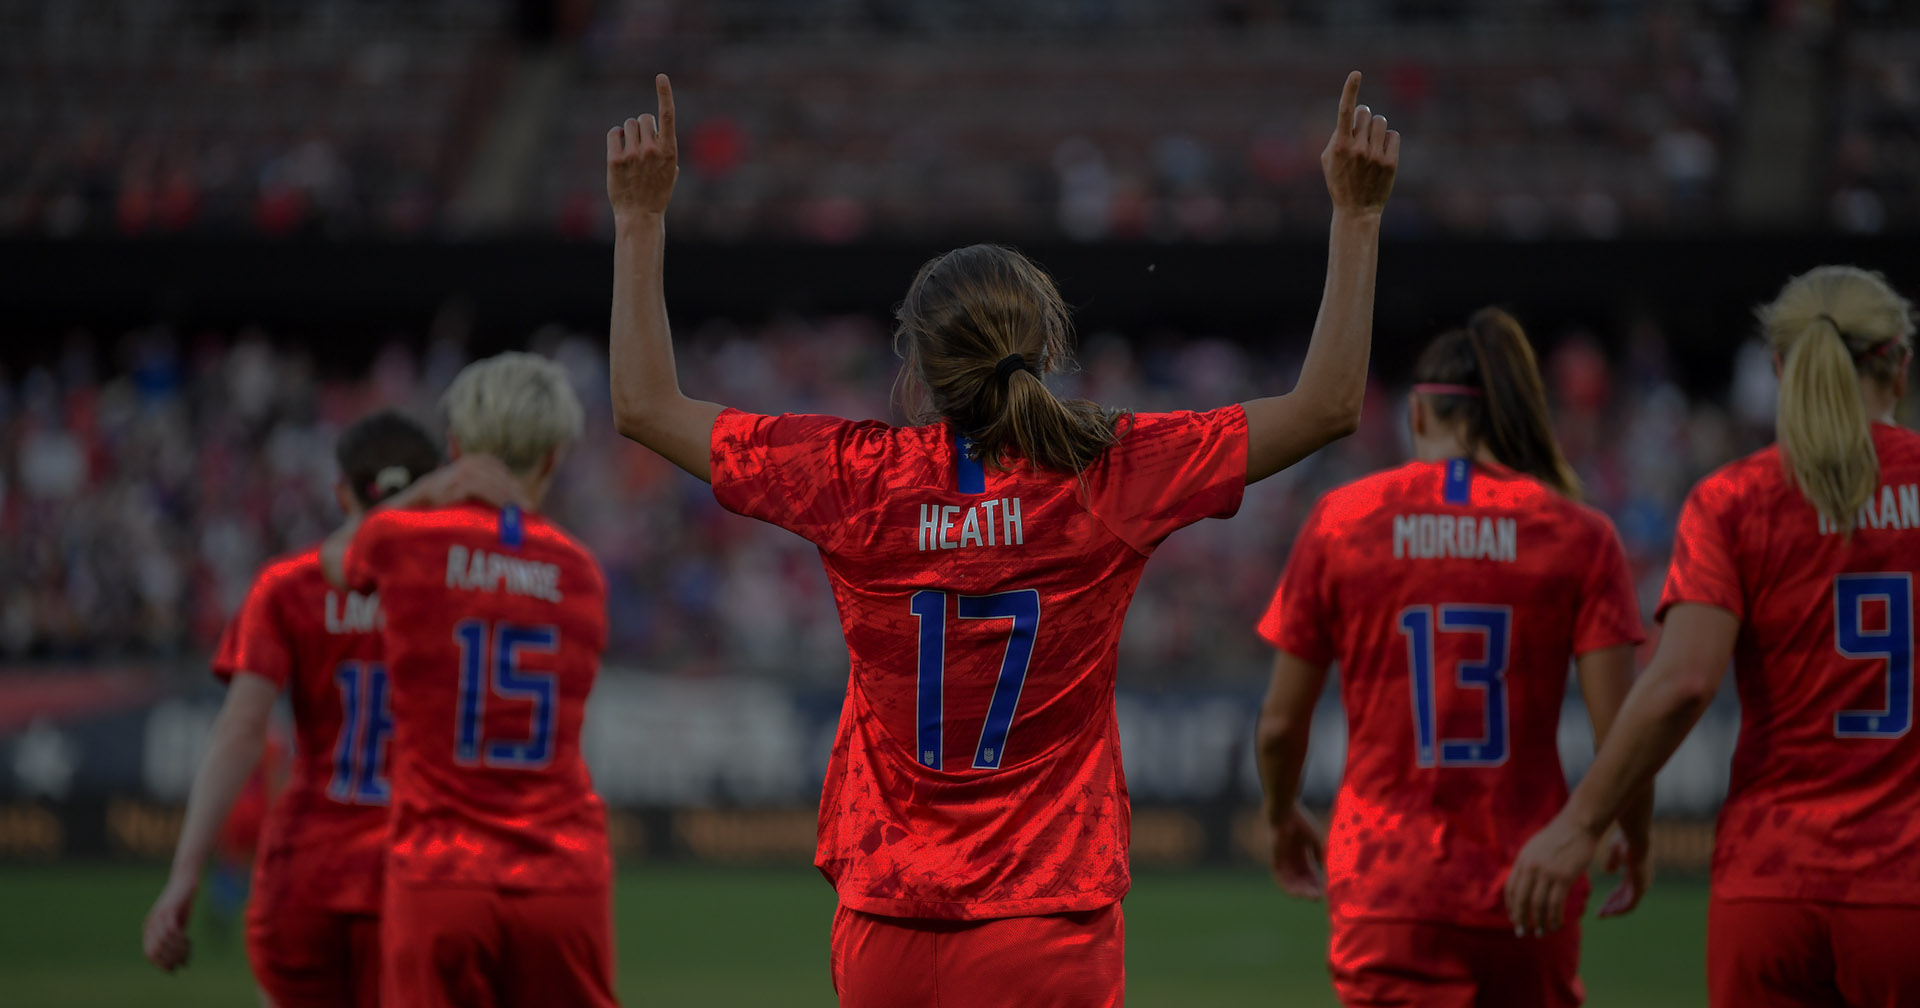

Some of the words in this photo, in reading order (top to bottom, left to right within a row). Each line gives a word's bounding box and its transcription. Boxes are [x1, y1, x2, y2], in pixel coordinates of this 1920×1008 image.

[919, 497, 1024, 551] HEATH
[1392, 513, 1517, 563] MORGAN
[1817, 483, 1920, 536] RAN
[453, 617, 561, 771] 15
[910, 588, 1041, 772] 17
[1397, 603, 1513, 768] 13
[1832, 570, 1914, 739] 9
